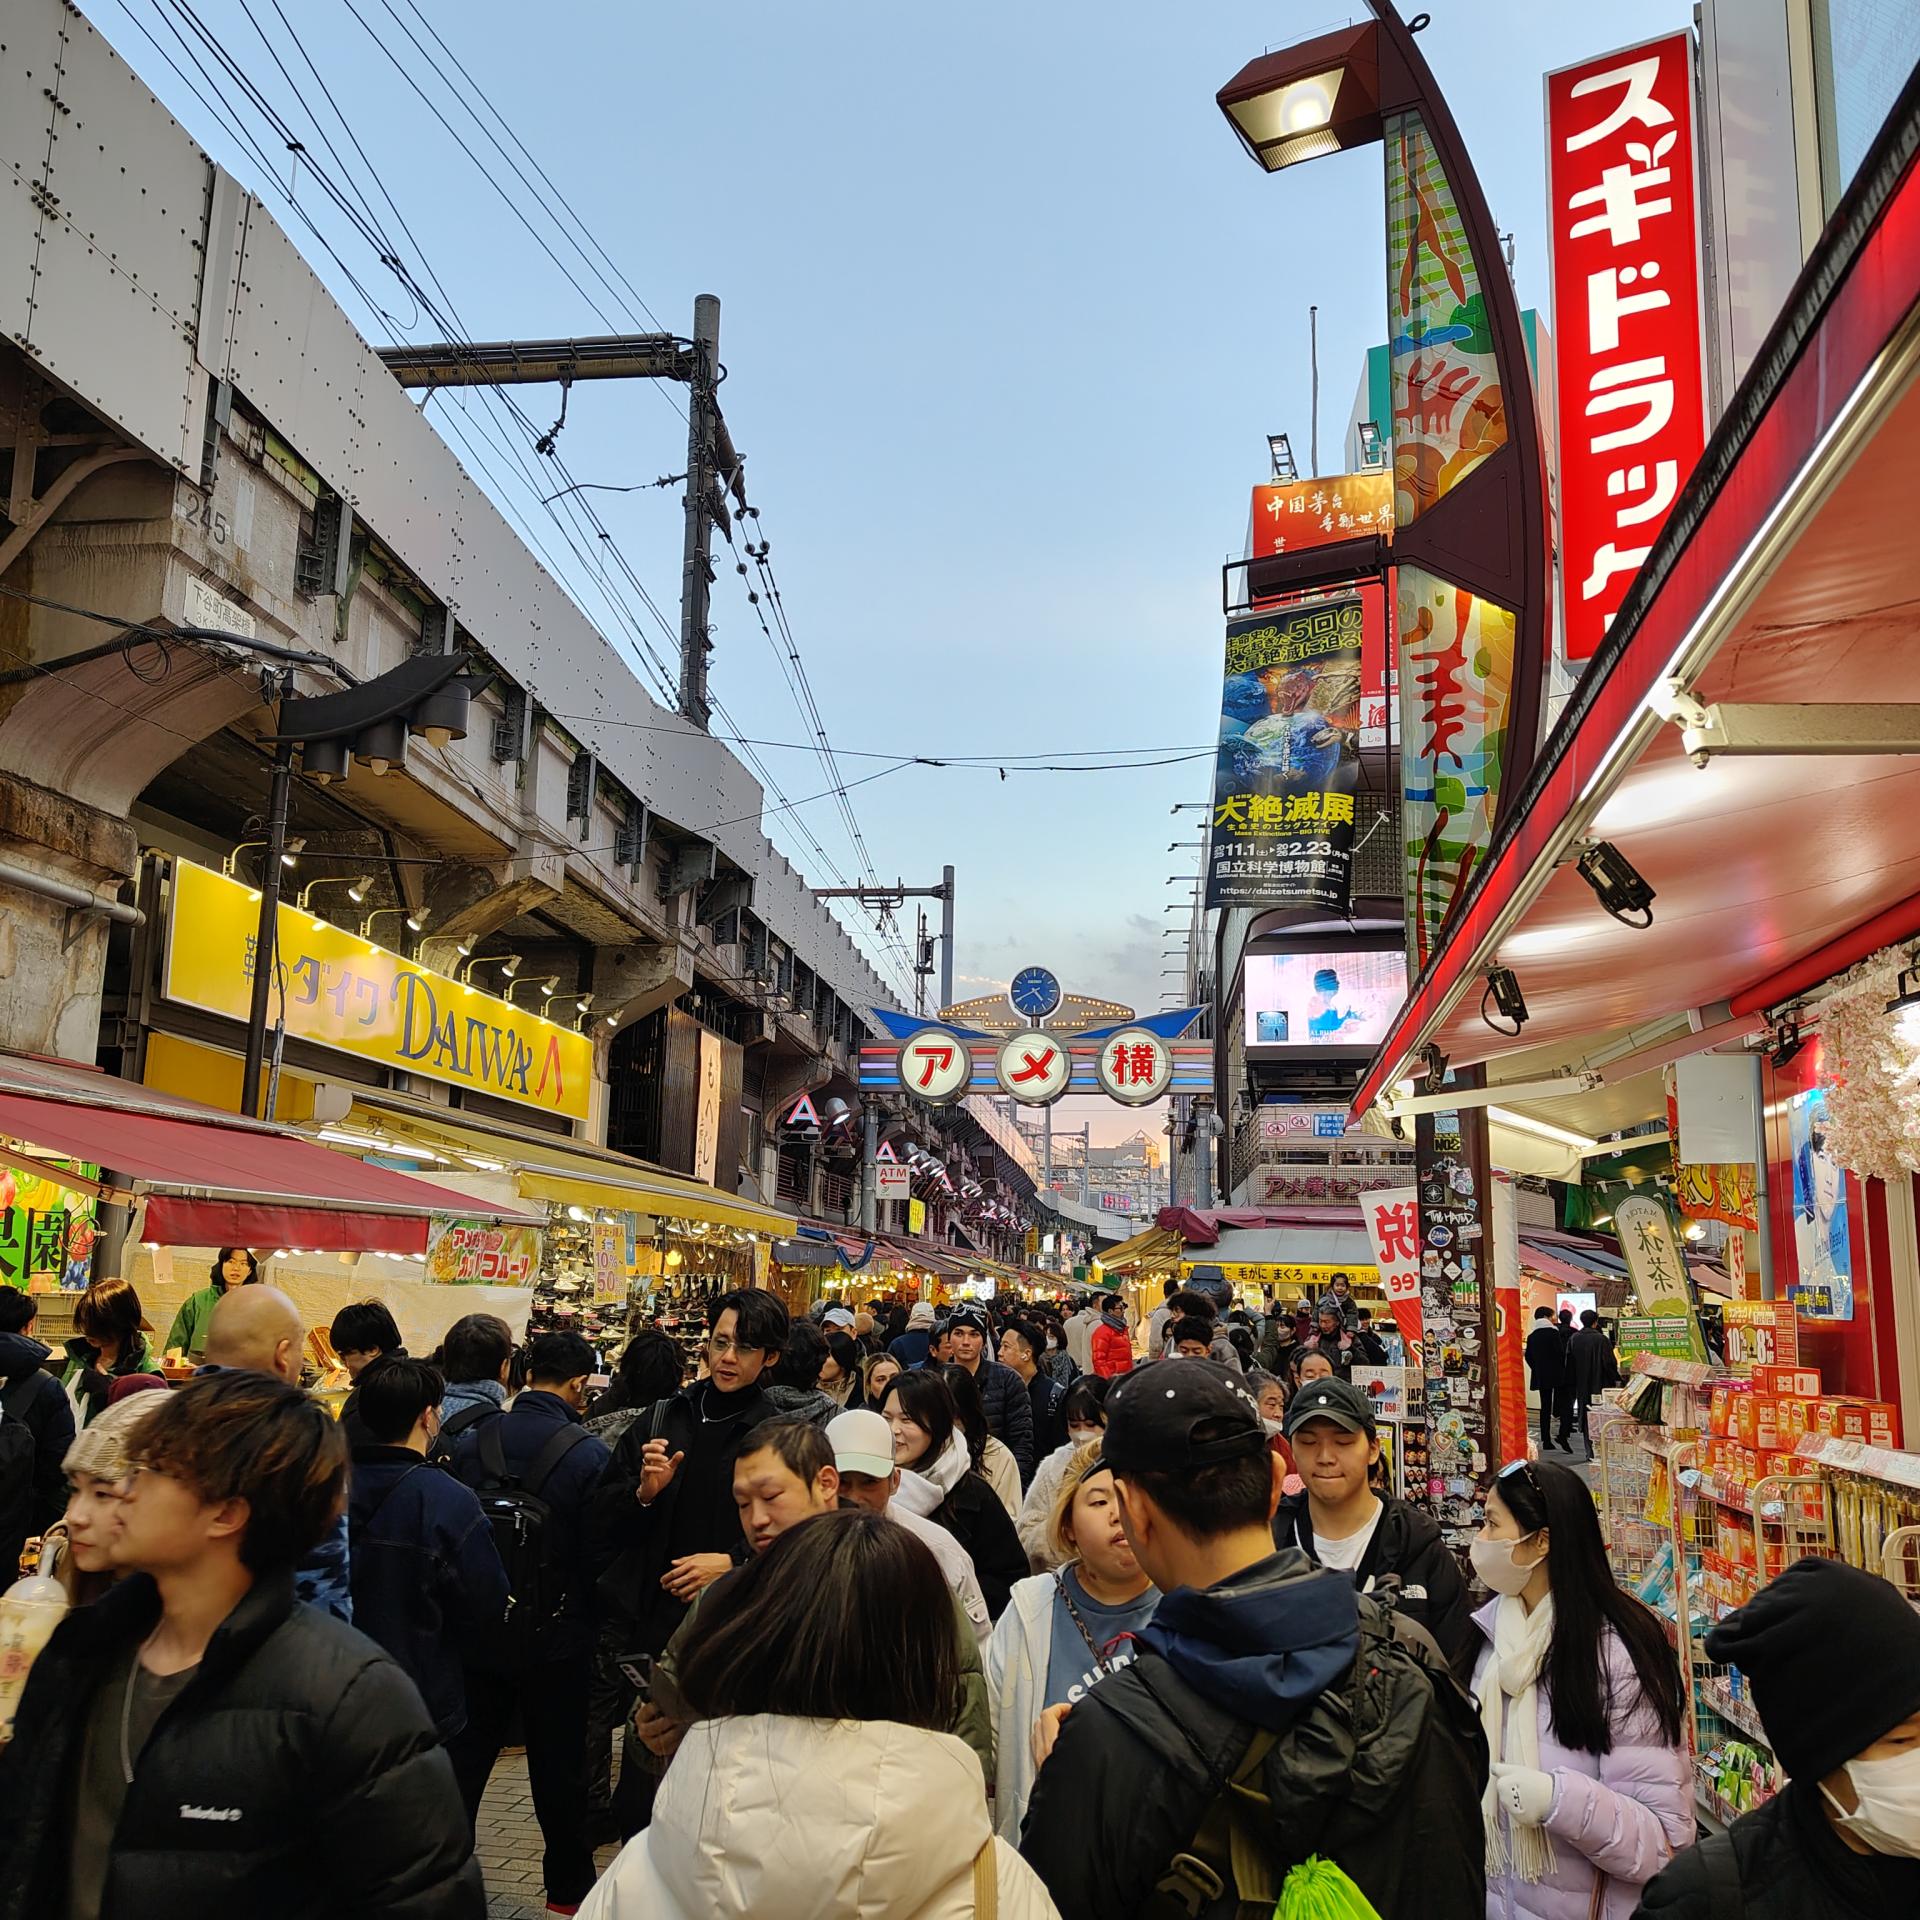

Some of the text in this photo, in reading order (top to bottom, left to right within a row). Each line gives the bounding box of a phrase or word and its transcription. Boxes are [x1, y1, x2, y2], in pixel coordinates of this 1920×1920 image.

[186, 493, 227, 544] 245
[1214, 792, 1354, 827] 大絶滅展
[1216, 861, 1326, 874] 国立科学博物館
[1220, 887, 1338, 899] https://daizetsumetsu.jp
[391, 971, 533, 1095] DAIWA
[912, 1042, 1157, 1090] アメ横
[787, 1095, 821, 1125] A
[880, 1168, 907, 1178] ATM
[1238, 1266, 1268, 1281] 毛がに
[1273, 1268, 1304, 1281] まぐろ
[1385, 1402, 1397, 1413] 650
